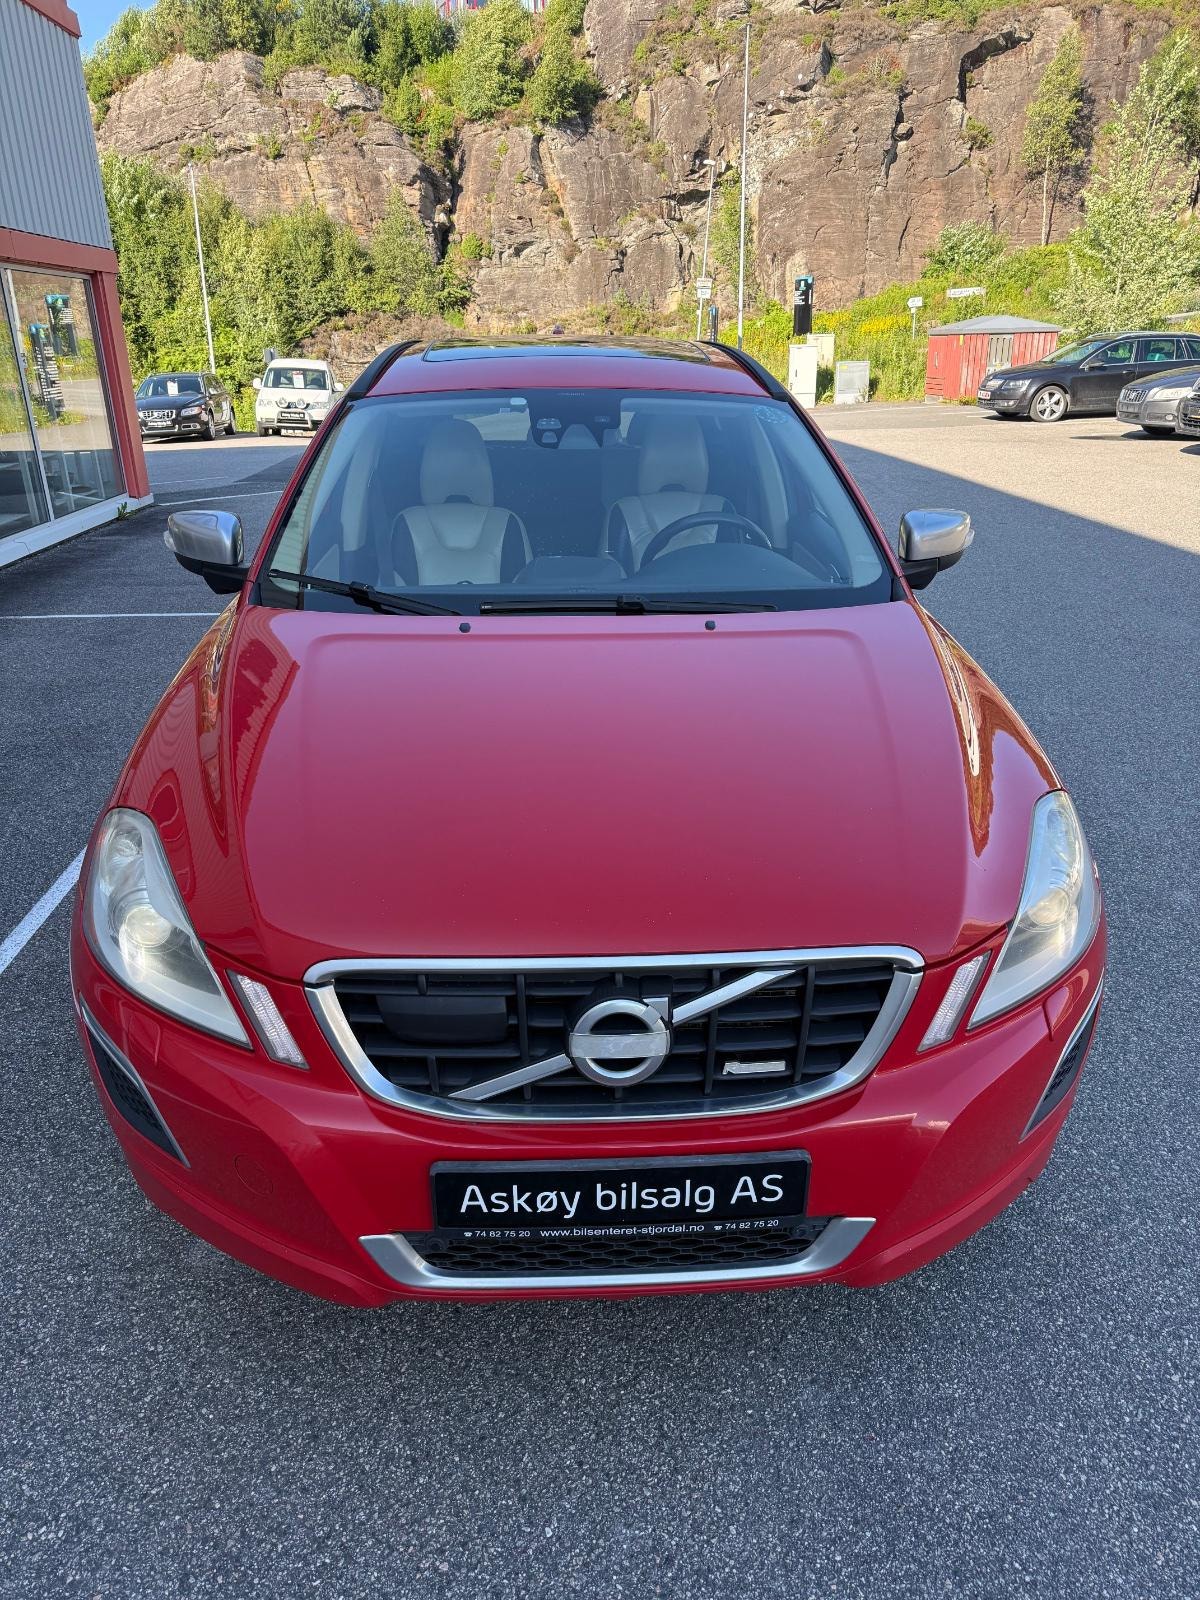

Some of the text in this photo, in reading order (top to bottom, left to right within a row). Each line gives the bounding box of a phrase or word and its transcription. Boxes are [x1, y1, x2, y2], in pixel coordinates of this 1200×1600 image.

[460, 1174, 784, 1219] Askøy bilsalg AS
[474, 1230, 487, 1238] 74
[489, 1230, 502, 1238] 82
[504, 1230, 516, 1238] 75
[518, 1230, 531, 1238] 20
[540, 1224, 705, 1238] www.bilsenteret-stjordal.no
[767, 1219, 779, 1227] 20
